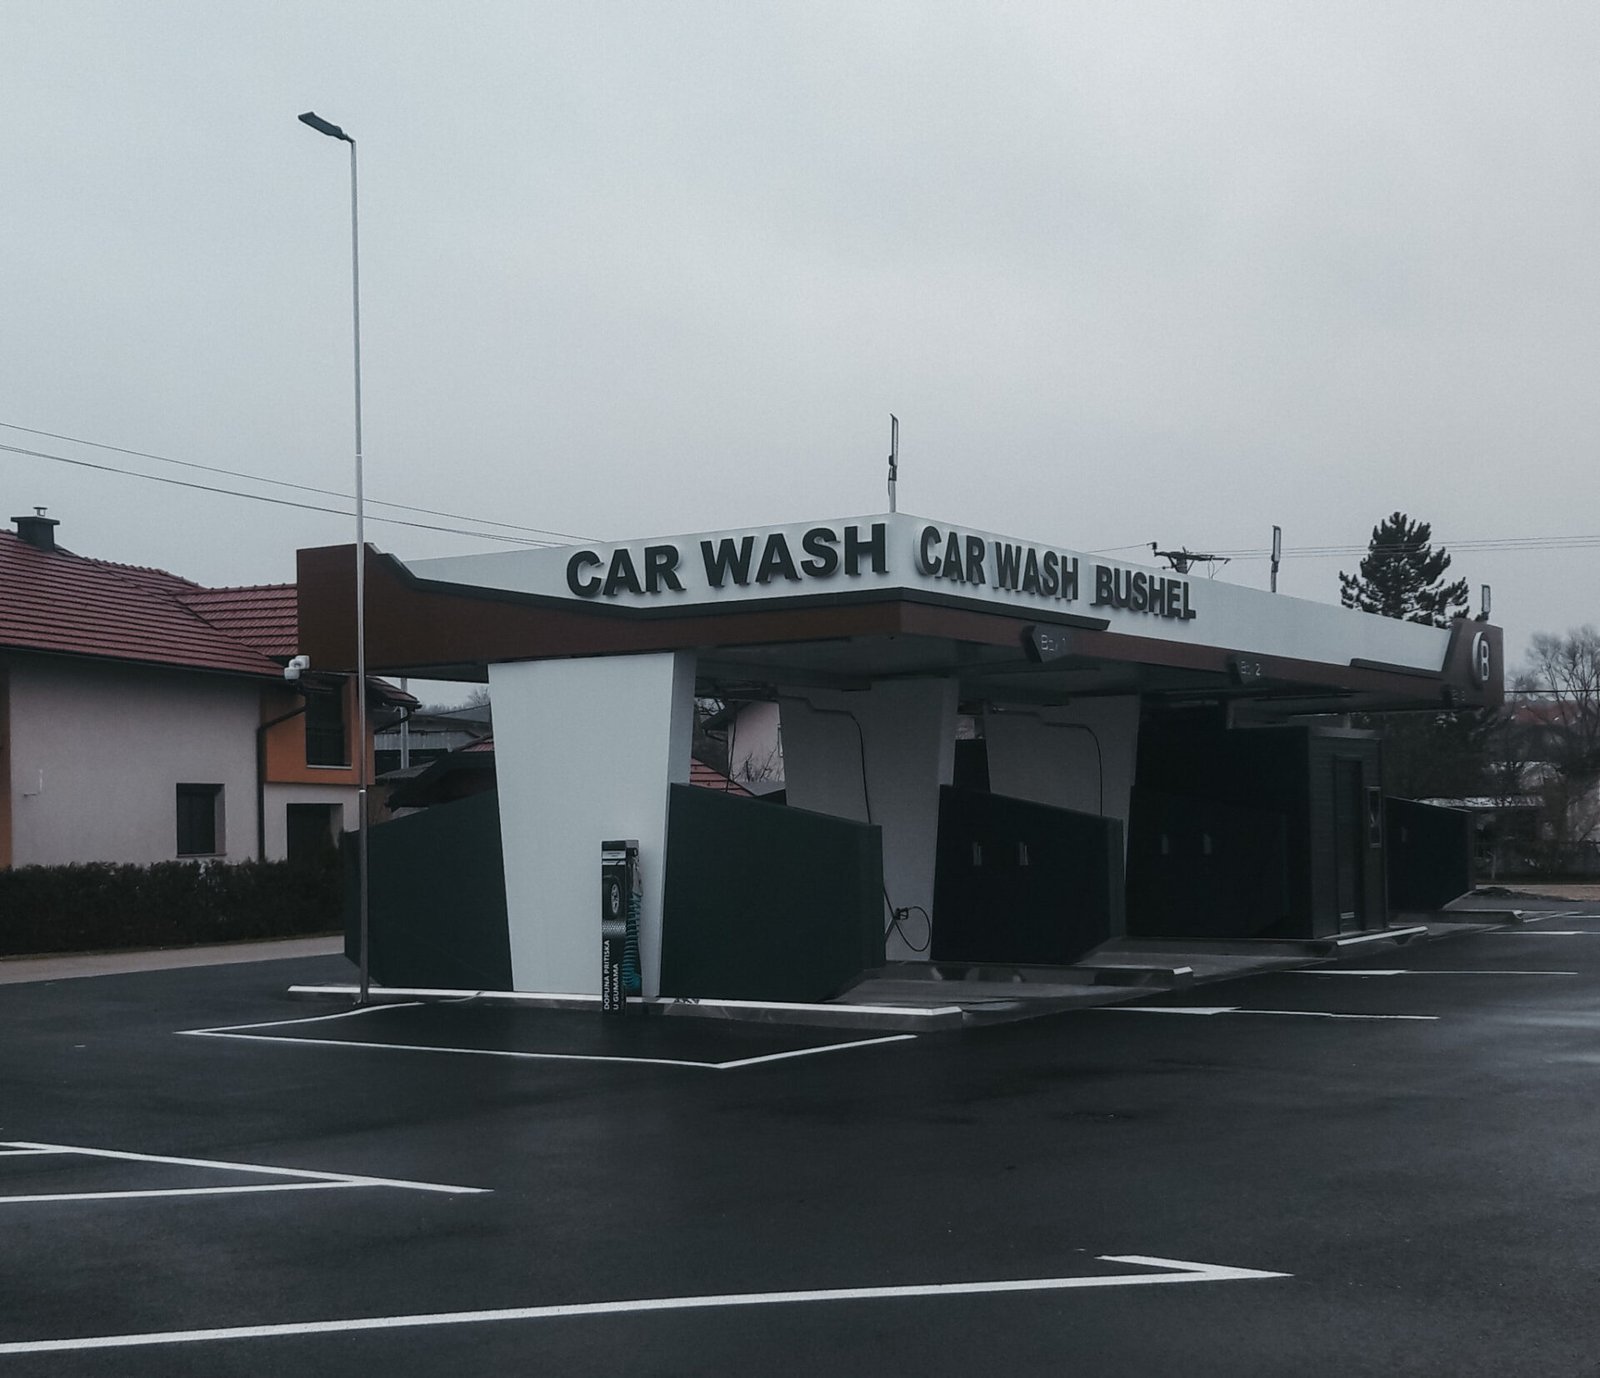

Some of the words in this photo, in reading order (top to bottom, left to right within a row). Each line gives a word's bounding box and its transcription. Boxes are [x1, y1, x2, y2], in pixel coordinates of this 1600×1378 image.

[567, 545, 686, 596] CAR
[701, 523, 889, 588] WASH
[914, 526, 987, 584] CAR
[990, 540, 1078, 601] WASH
[1092, 564, 1196, 619] BUSHEL
